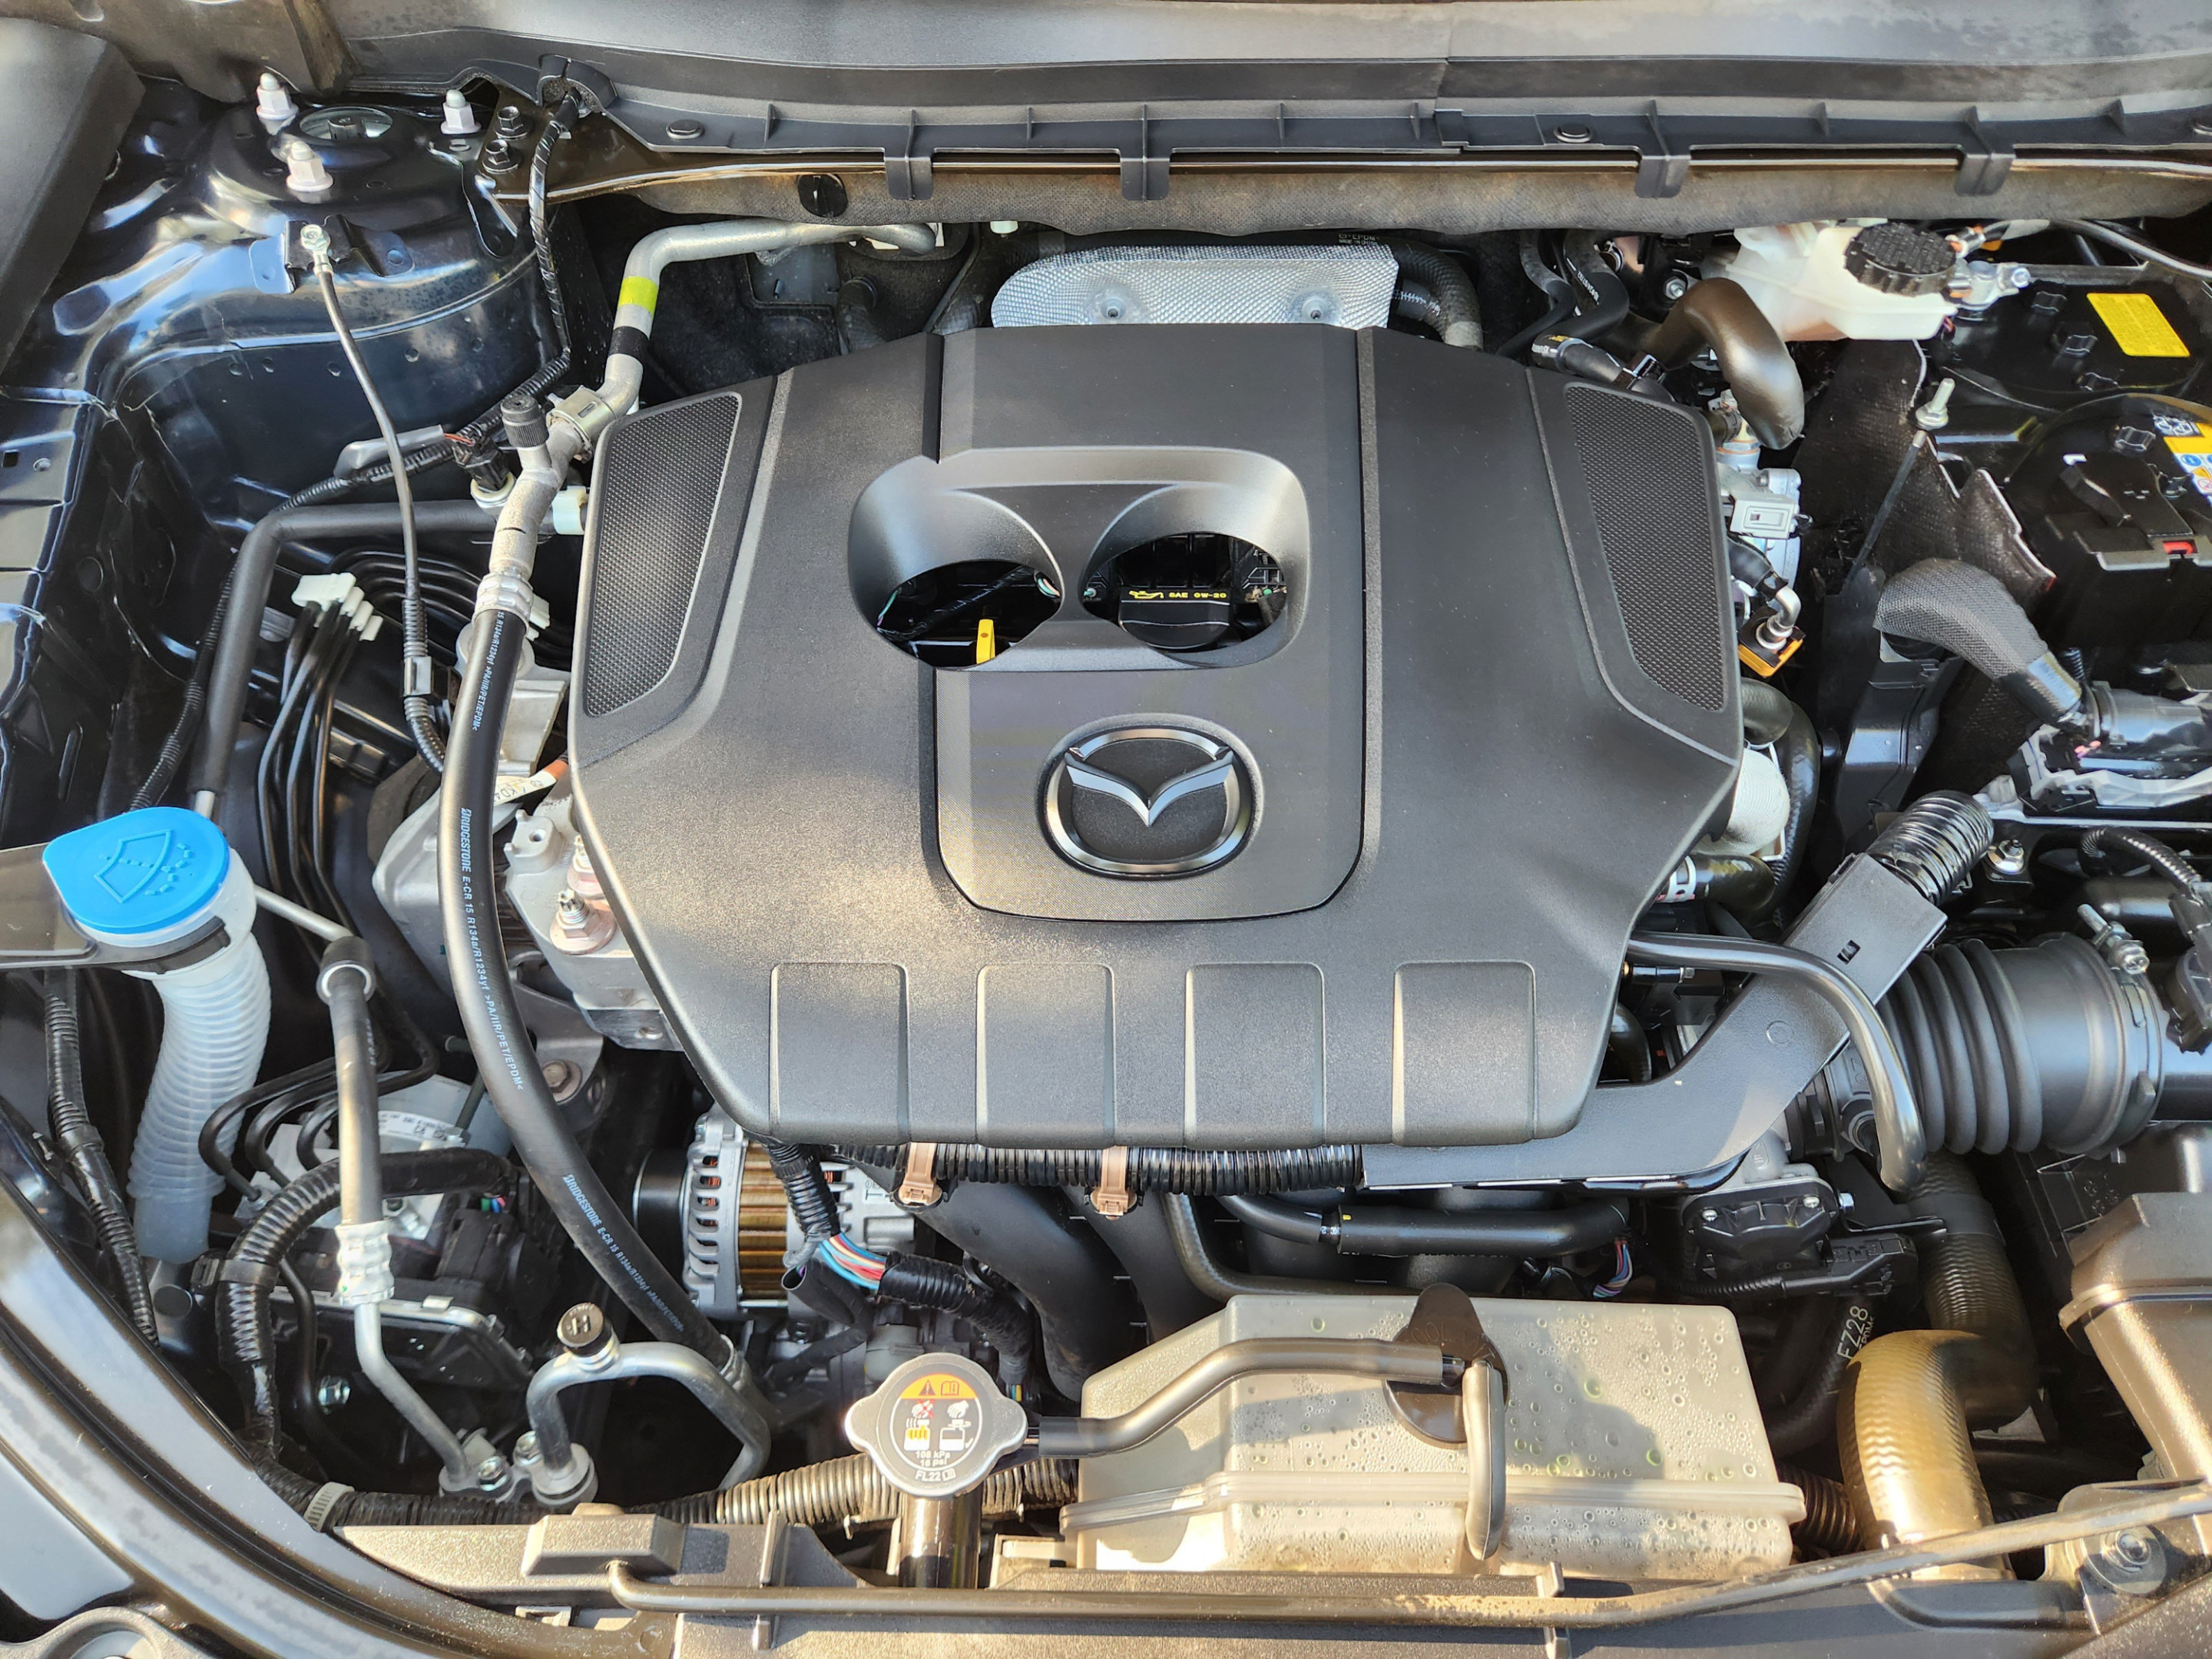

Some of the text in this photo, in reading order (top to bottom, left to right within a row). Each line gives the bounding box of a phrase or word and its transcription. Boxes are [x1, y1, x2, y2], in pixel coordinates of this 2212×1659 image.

[461, 807, 472, 873] BRIDGESTONE
[465, 903, 474, 914] 15
[562, 1174, 602, 1227] BRIDGESTONE
[1836, 1305, 1869, 1359] FZ28
[933, 1451, 951, 1459] kPa
[915, 1470, 942, 1482] FL22
